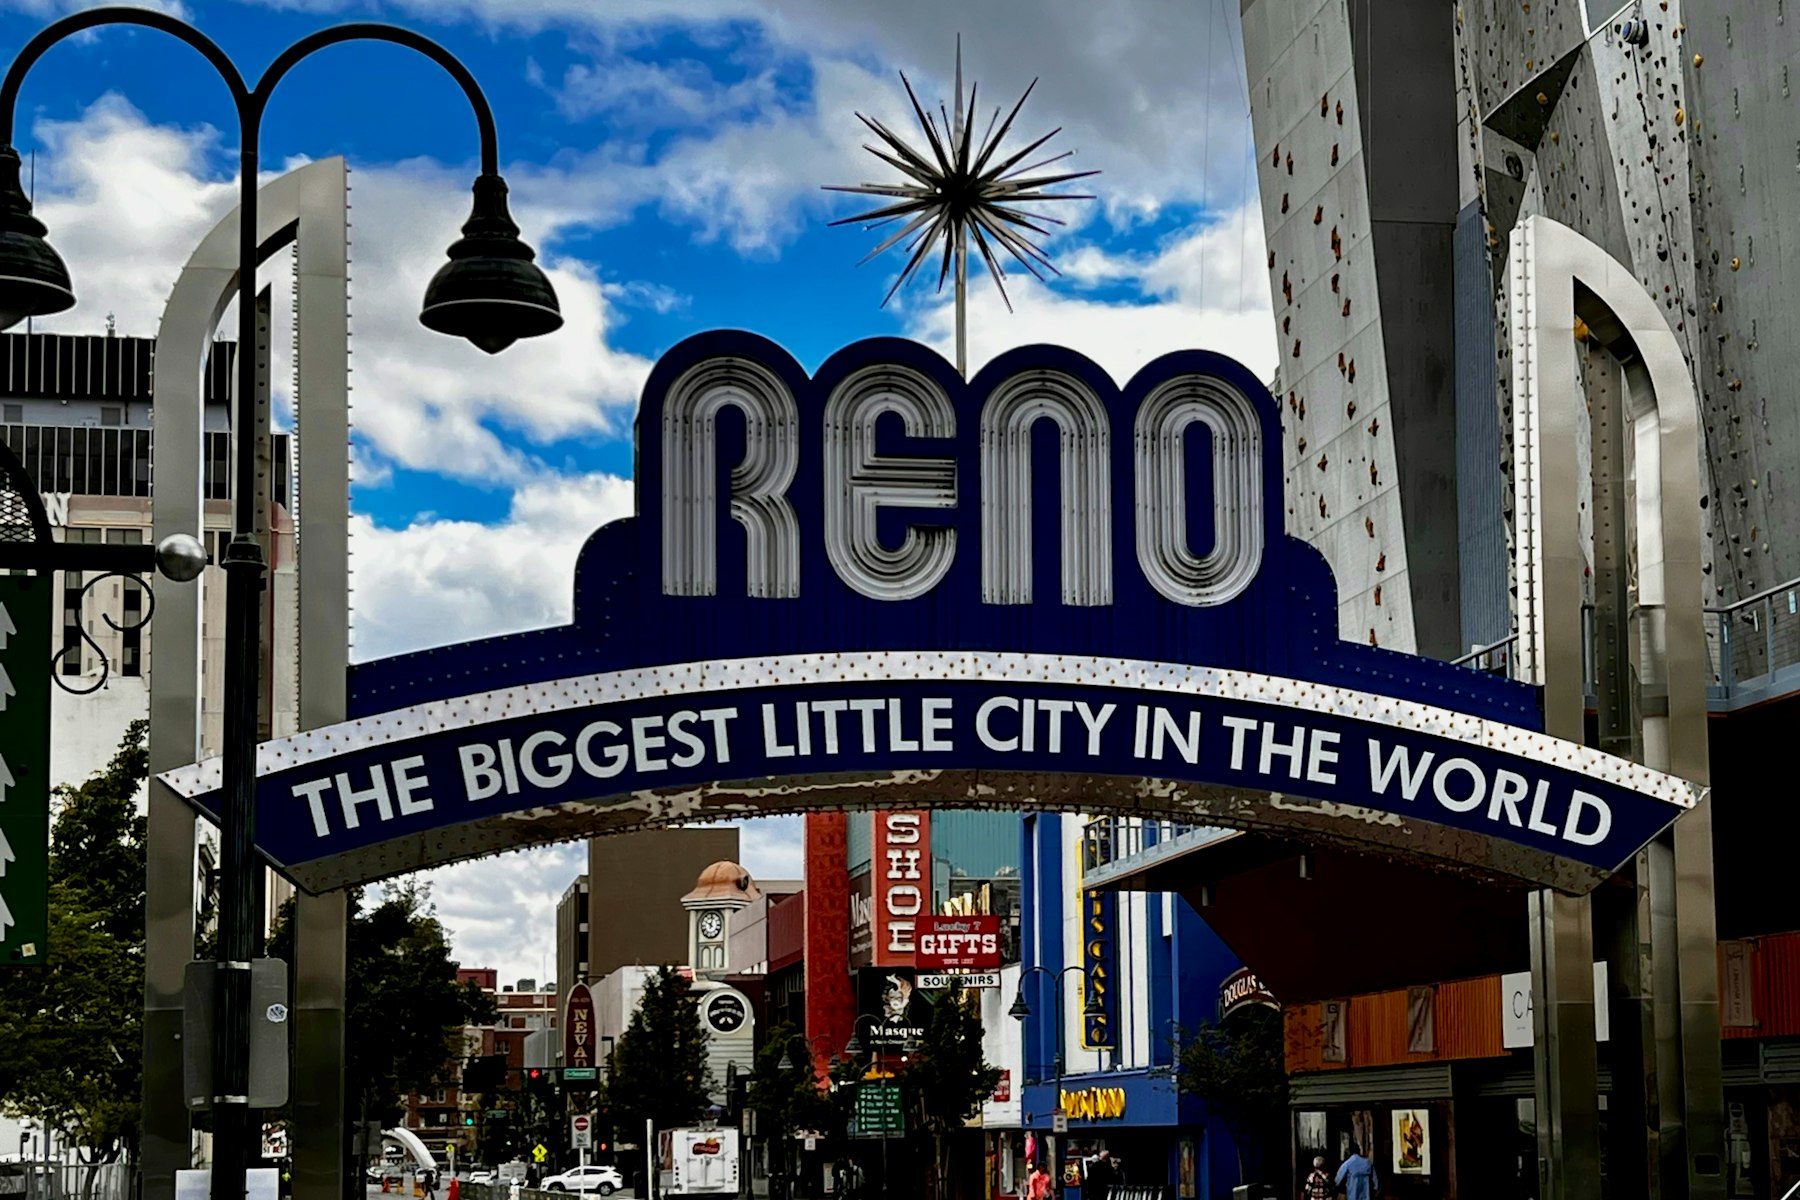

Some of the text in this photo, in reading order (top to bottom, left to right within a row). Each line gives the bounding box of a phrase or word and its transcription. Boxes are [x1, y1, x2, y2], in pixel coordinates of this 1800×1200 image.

[662, 356, 1263, 608] RENO
[292, 696, 1612, 847] THE BIGGEST LITTLE CITY IN THE WORLD
[886, 813, 922, 953] SHOE
[973, 921, 982, 931] 7
[921, 933, 997, 955] GIFTS
[923, 975, 994, 986] SOUENIRS
[1223, 974, 1257, 1008] DOUGLAS
[870, 1025, 924, 1038] Masque
